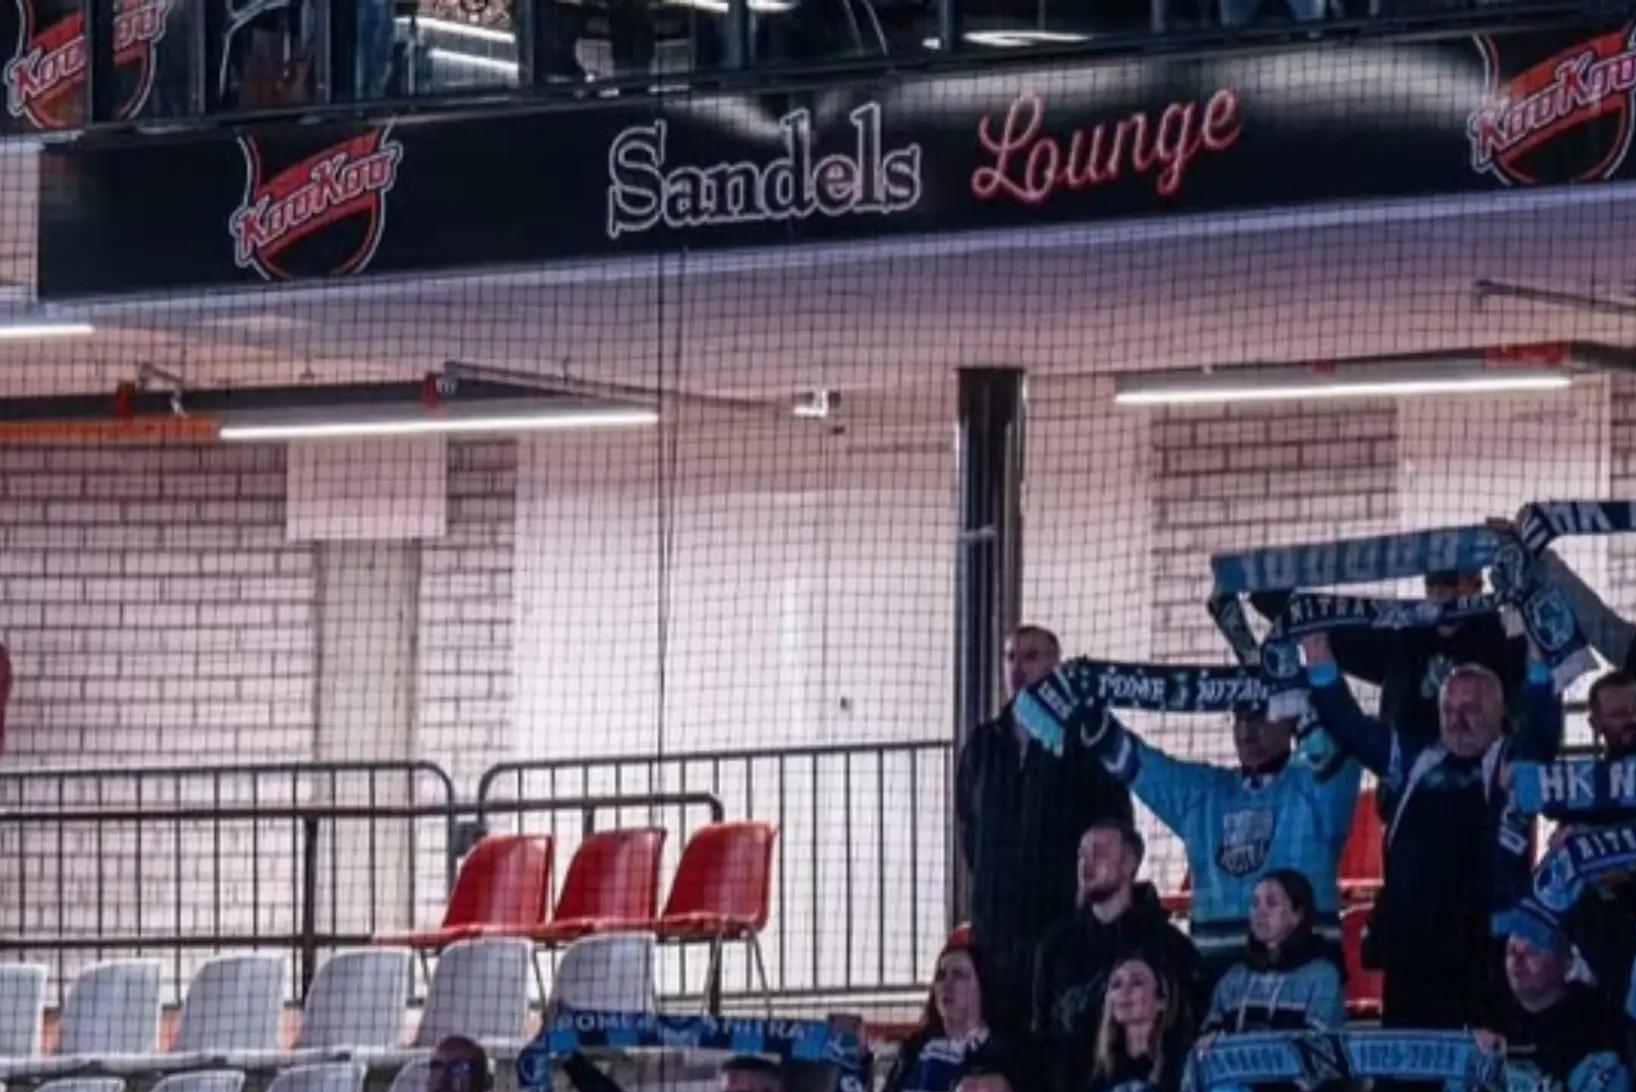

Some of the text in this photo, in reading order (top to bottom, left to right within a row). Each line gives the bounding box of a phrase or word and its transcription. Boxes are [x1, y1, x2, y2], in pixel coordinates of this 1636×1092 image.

[607, 88, 1240, 238] Sandels Lounge
[1539, 764, 1596, 802] HK
